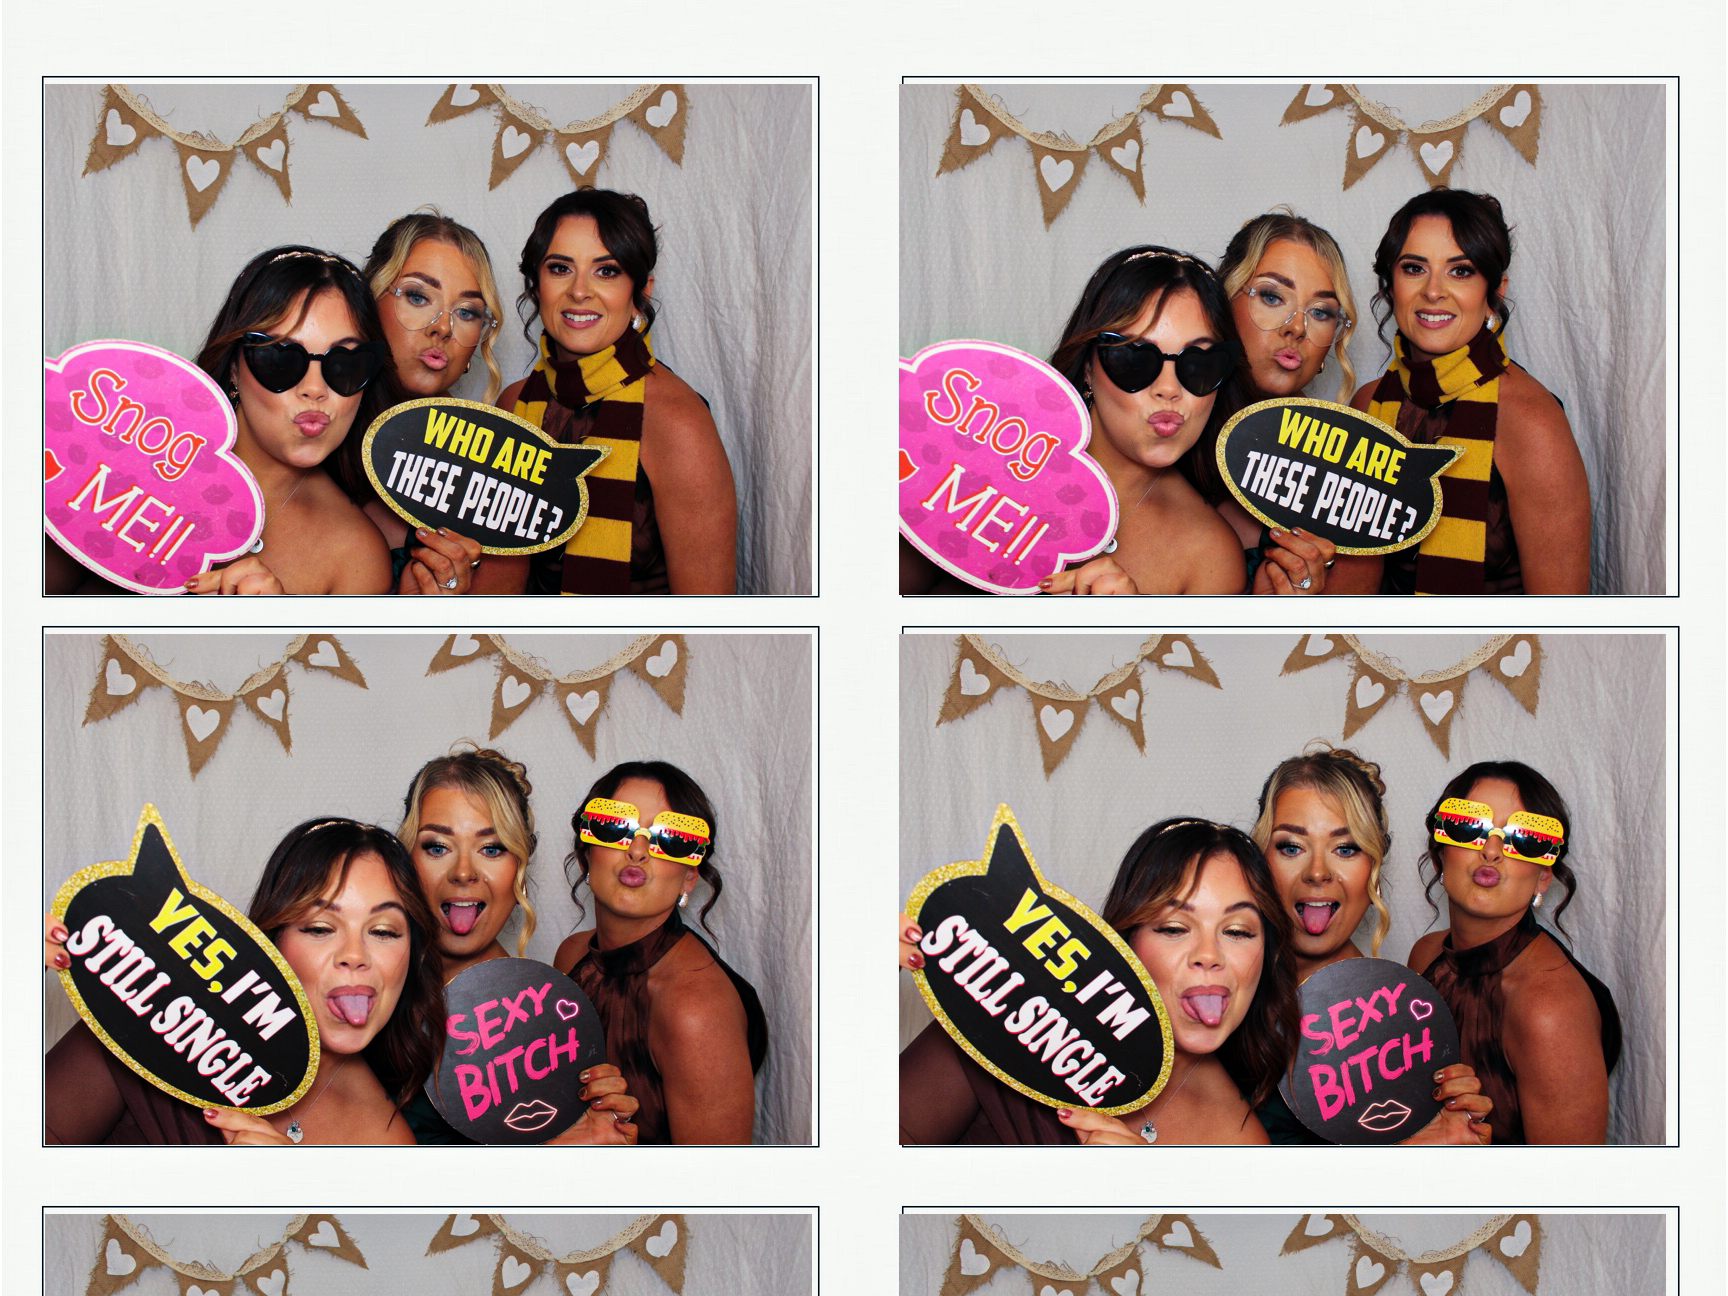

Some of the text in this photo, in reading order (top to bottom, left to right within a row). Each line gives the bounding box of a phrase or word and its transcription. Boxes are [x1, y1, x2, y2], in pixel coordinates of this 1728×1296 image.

[70, 368, 207, 481] Snog
[424, 408, 552, 485] WHO ARE
[924, 368, 1061, 481] Snog
[1278, 408, 1406, 485] WHO ARE
[66, 461, 195, 565] ME!!
[386, 451, 563, 542] THESE PEOPLE?
[920, 461, 1049, 565] ME!!
[1240, 451, 1417, 542] THESE PEOPLE?
[66, 915, 272, 1107] STILL SINGLE
[149, 887, 297, 1041] YES, I'M
[920, 915, 1126, 1107] STILL SINGLE
[1003, 887, 1151, 1041] YES, I'M
[446, 983, 552, 1056] SEXY
[1300, 983, 1406, 1056] SEXY
[454, 1027, 580, 1122] BITCH
[1308, 1027, 1434, 1122] BITCH
